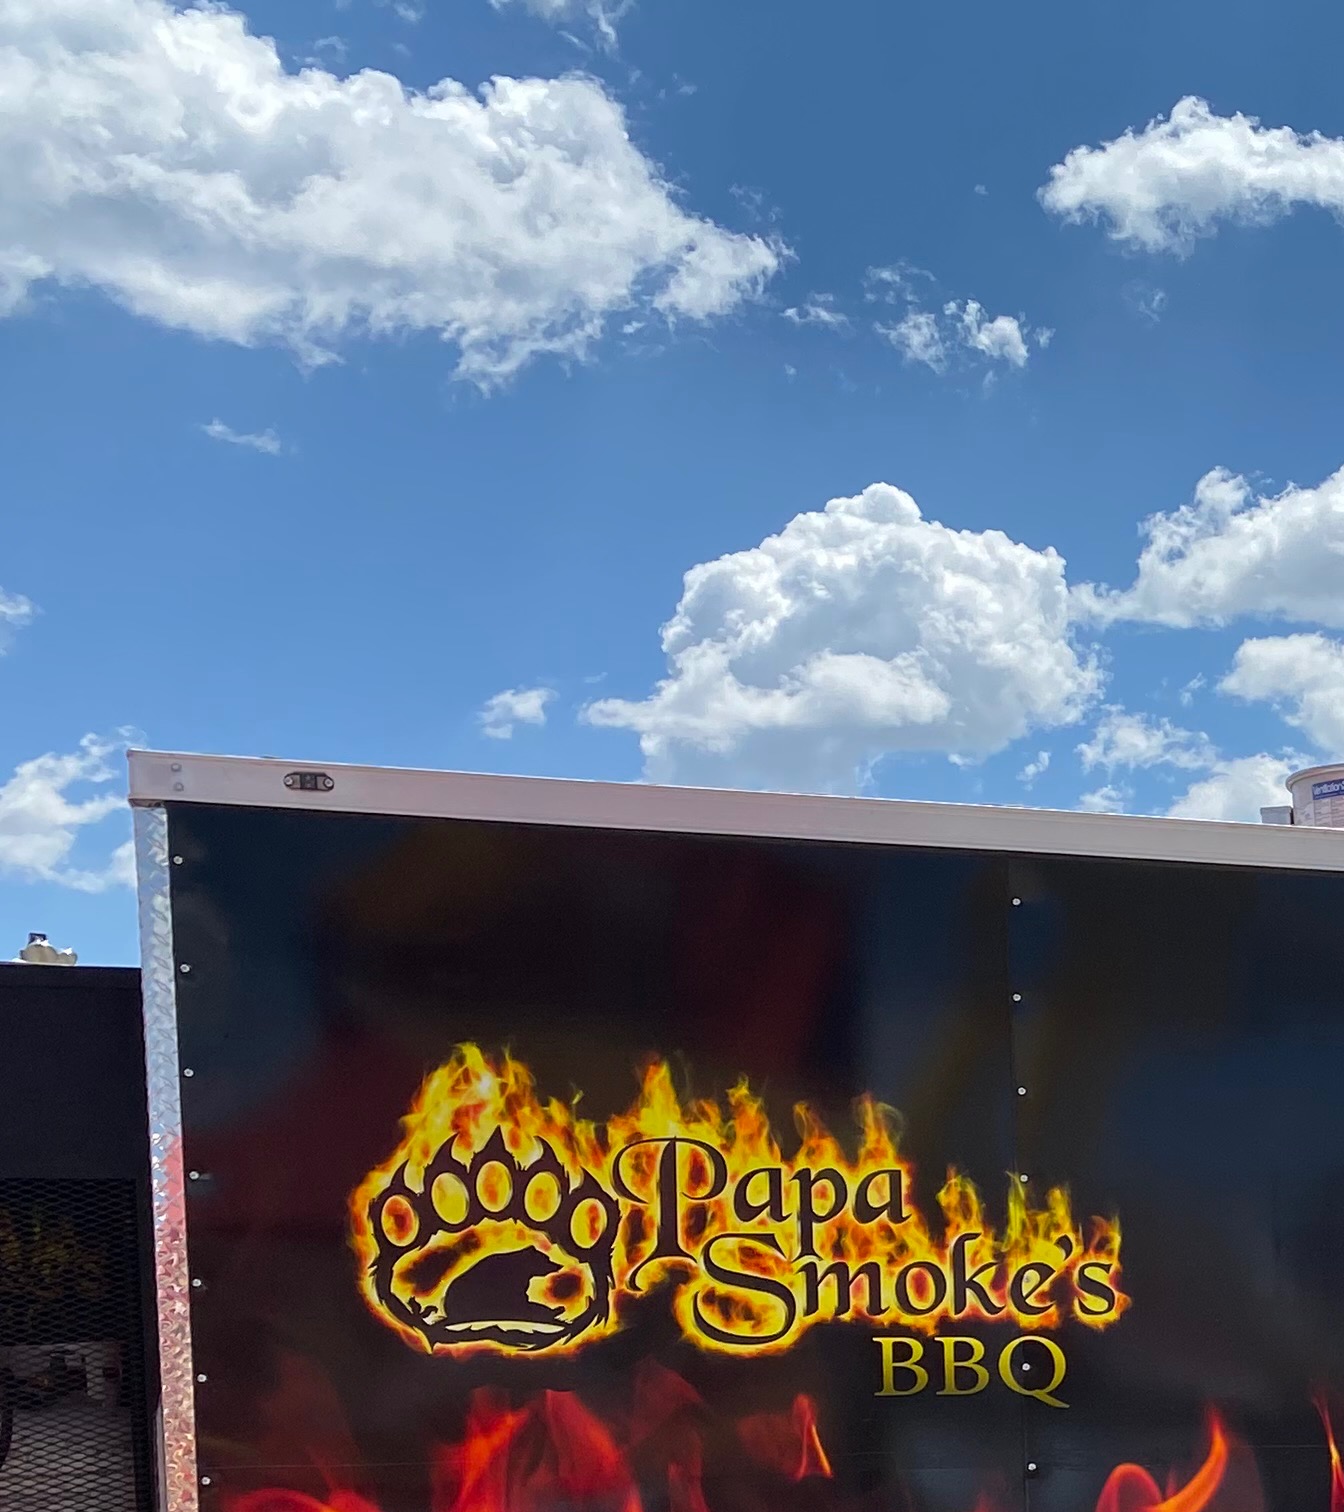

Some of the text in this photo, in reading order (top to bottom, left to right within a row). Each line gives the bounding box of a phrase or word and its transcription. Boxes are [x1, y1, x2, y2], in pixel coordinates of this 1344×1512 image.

[611, 1136, 909, 1292] Papa
[692, 1232, 1117, 1344] Smoke's
[873, 1336, 1070, 1408] BBQ
